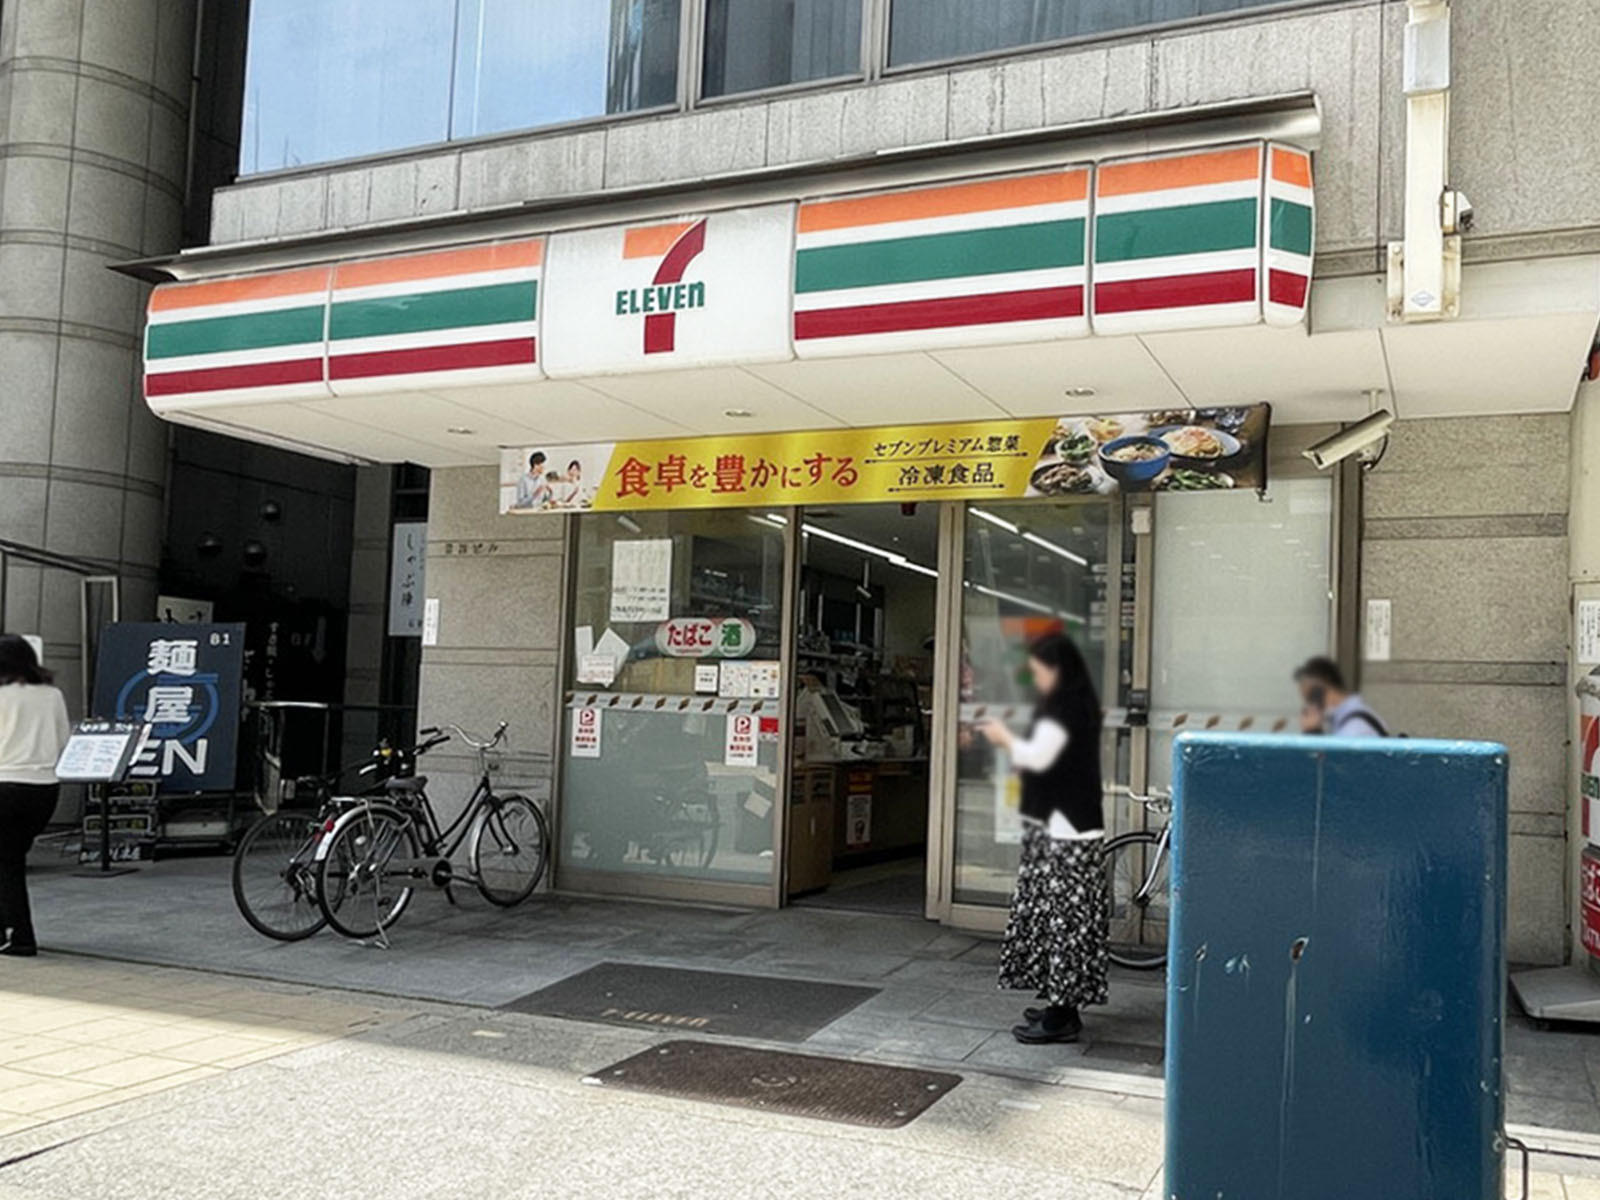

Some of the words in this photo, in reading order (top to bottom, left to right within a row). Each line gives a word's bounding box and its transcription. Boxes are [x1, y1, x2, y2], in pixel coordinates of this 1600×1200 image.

[622, 217, 709, 355] 7
[873, 434, 1021, 457] セブンプレミアム惣菜
[615, 452, 859, 499] 食卓を豊かにする
[898, 462, 995, 486] 冷凍食品
[667, 624, 713, 647] たばこ
[721, 623, 742, 647] 酒
[144, 639, 199, 723] 麺屋
